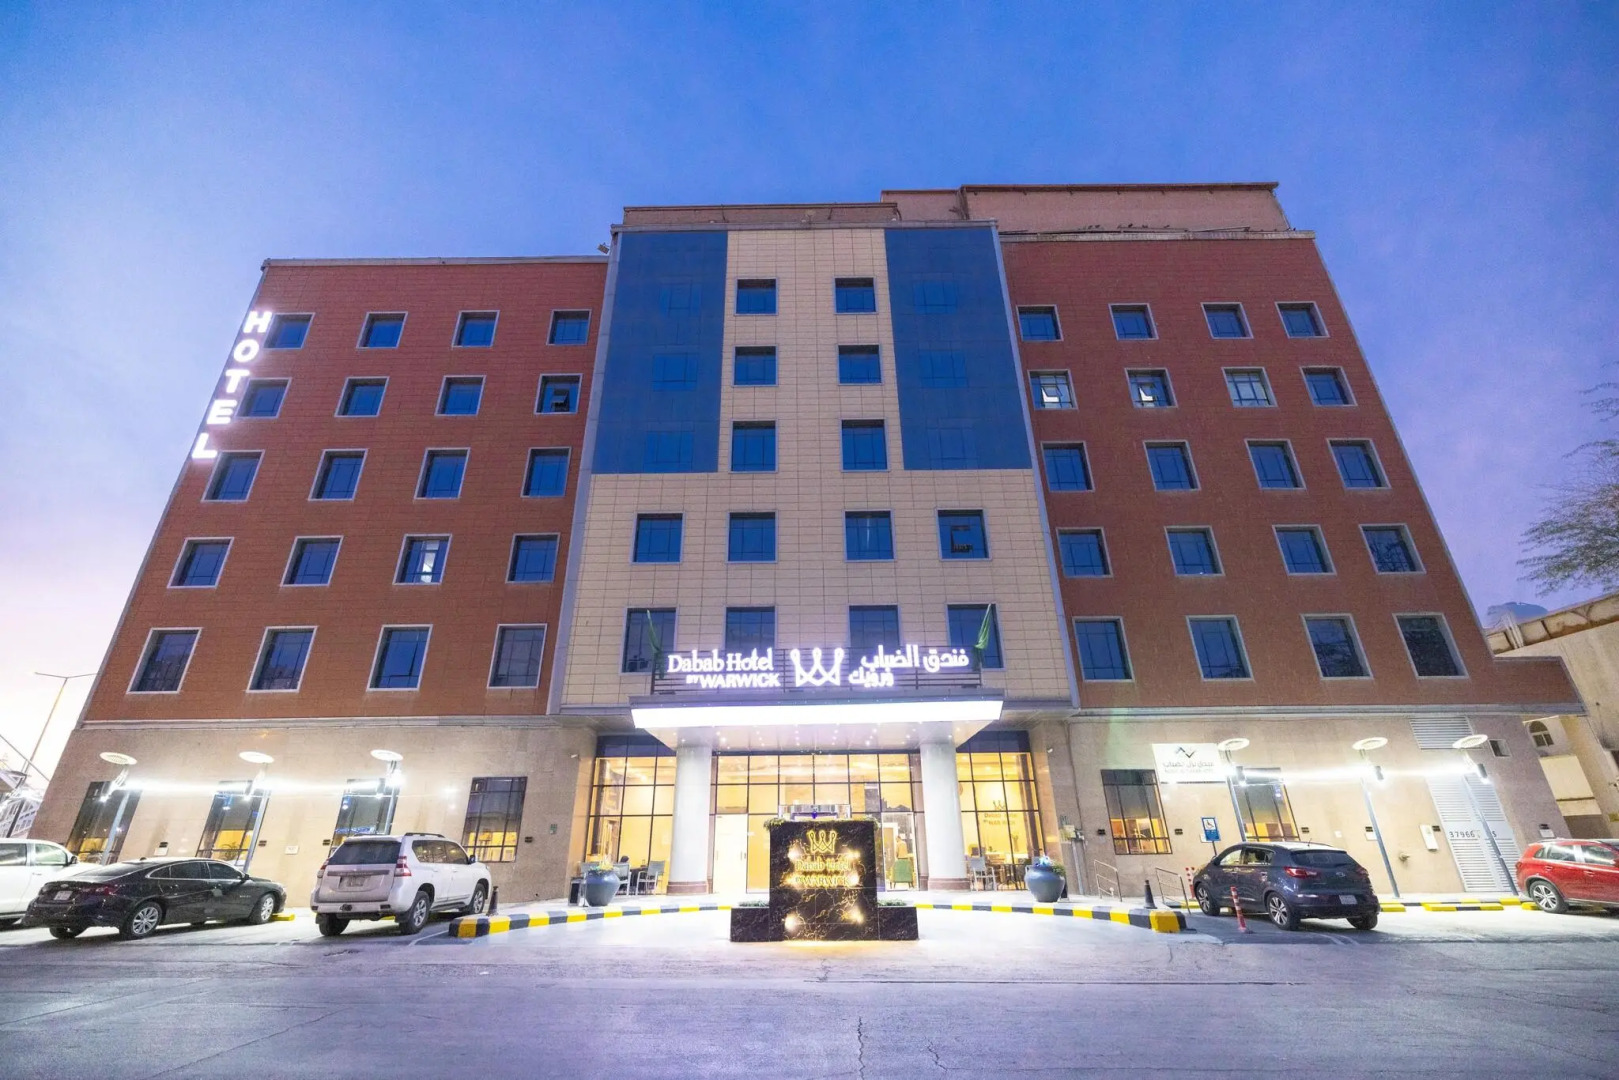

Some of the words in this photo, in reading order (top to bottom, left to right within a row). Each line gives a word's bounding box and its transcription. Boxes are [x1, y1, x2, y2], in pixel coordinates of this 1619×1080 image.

[191, 311, 273, 459] HOTEL
[667, 648, 725, 673] Dabab
[726, 647, 774, 672] Hotel
[860, 644, 921, 672] الضباب
[922, 648, 969, 673] فندق
[686, 676, 700, 684] BY
[700, 673, 781, 688] WARWICK
